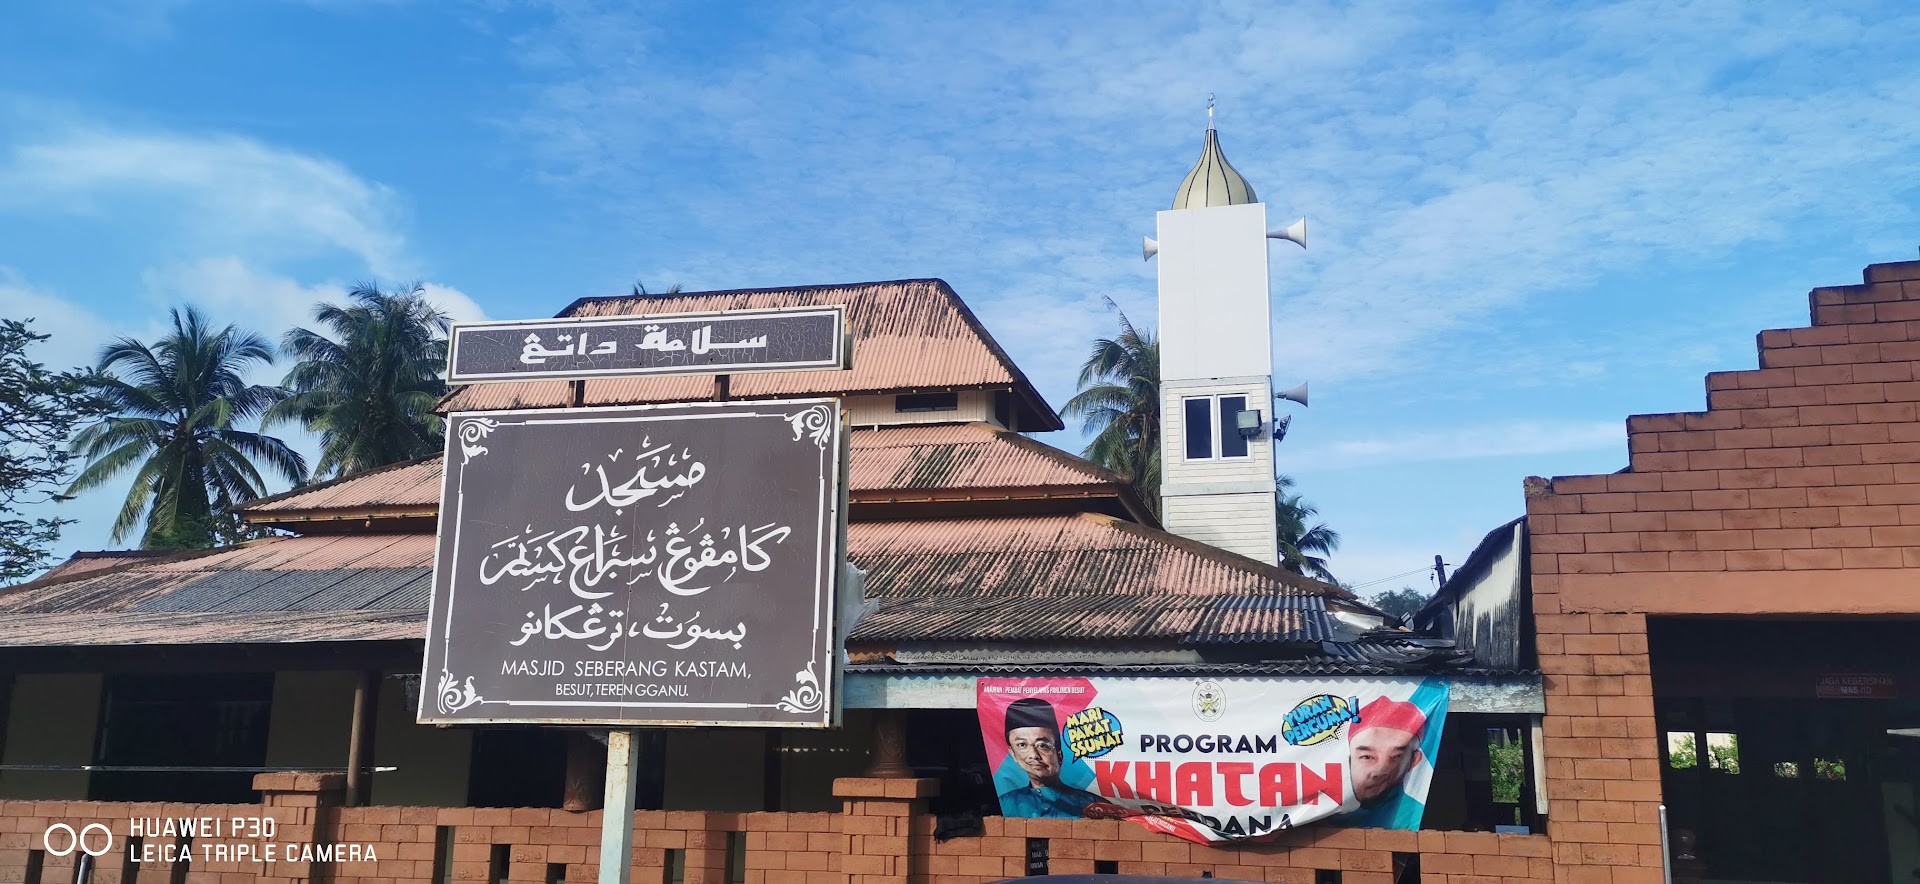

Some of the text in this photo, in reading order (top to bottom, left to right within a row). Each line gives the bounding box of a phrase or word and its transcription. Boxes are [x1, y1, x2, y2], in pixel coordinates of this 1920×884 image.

[501, 659, 752, 679] MASJID SEBERANG KASTAM,
[1821, 677, 1840, 685] JAGA
[1840, 686, 1872, 694] MASJID
[1067, 707, 1102, 728] MARI
[1283, 694, 1332, 727] YURAN
[1068, 719, 1110, 742] PAKAT
[1071, 730, 1121, 757] SSUNAT
[1140, 735, 1277, 753] PROGRAM
[1095, 761, 1342, 807] KHATAN
